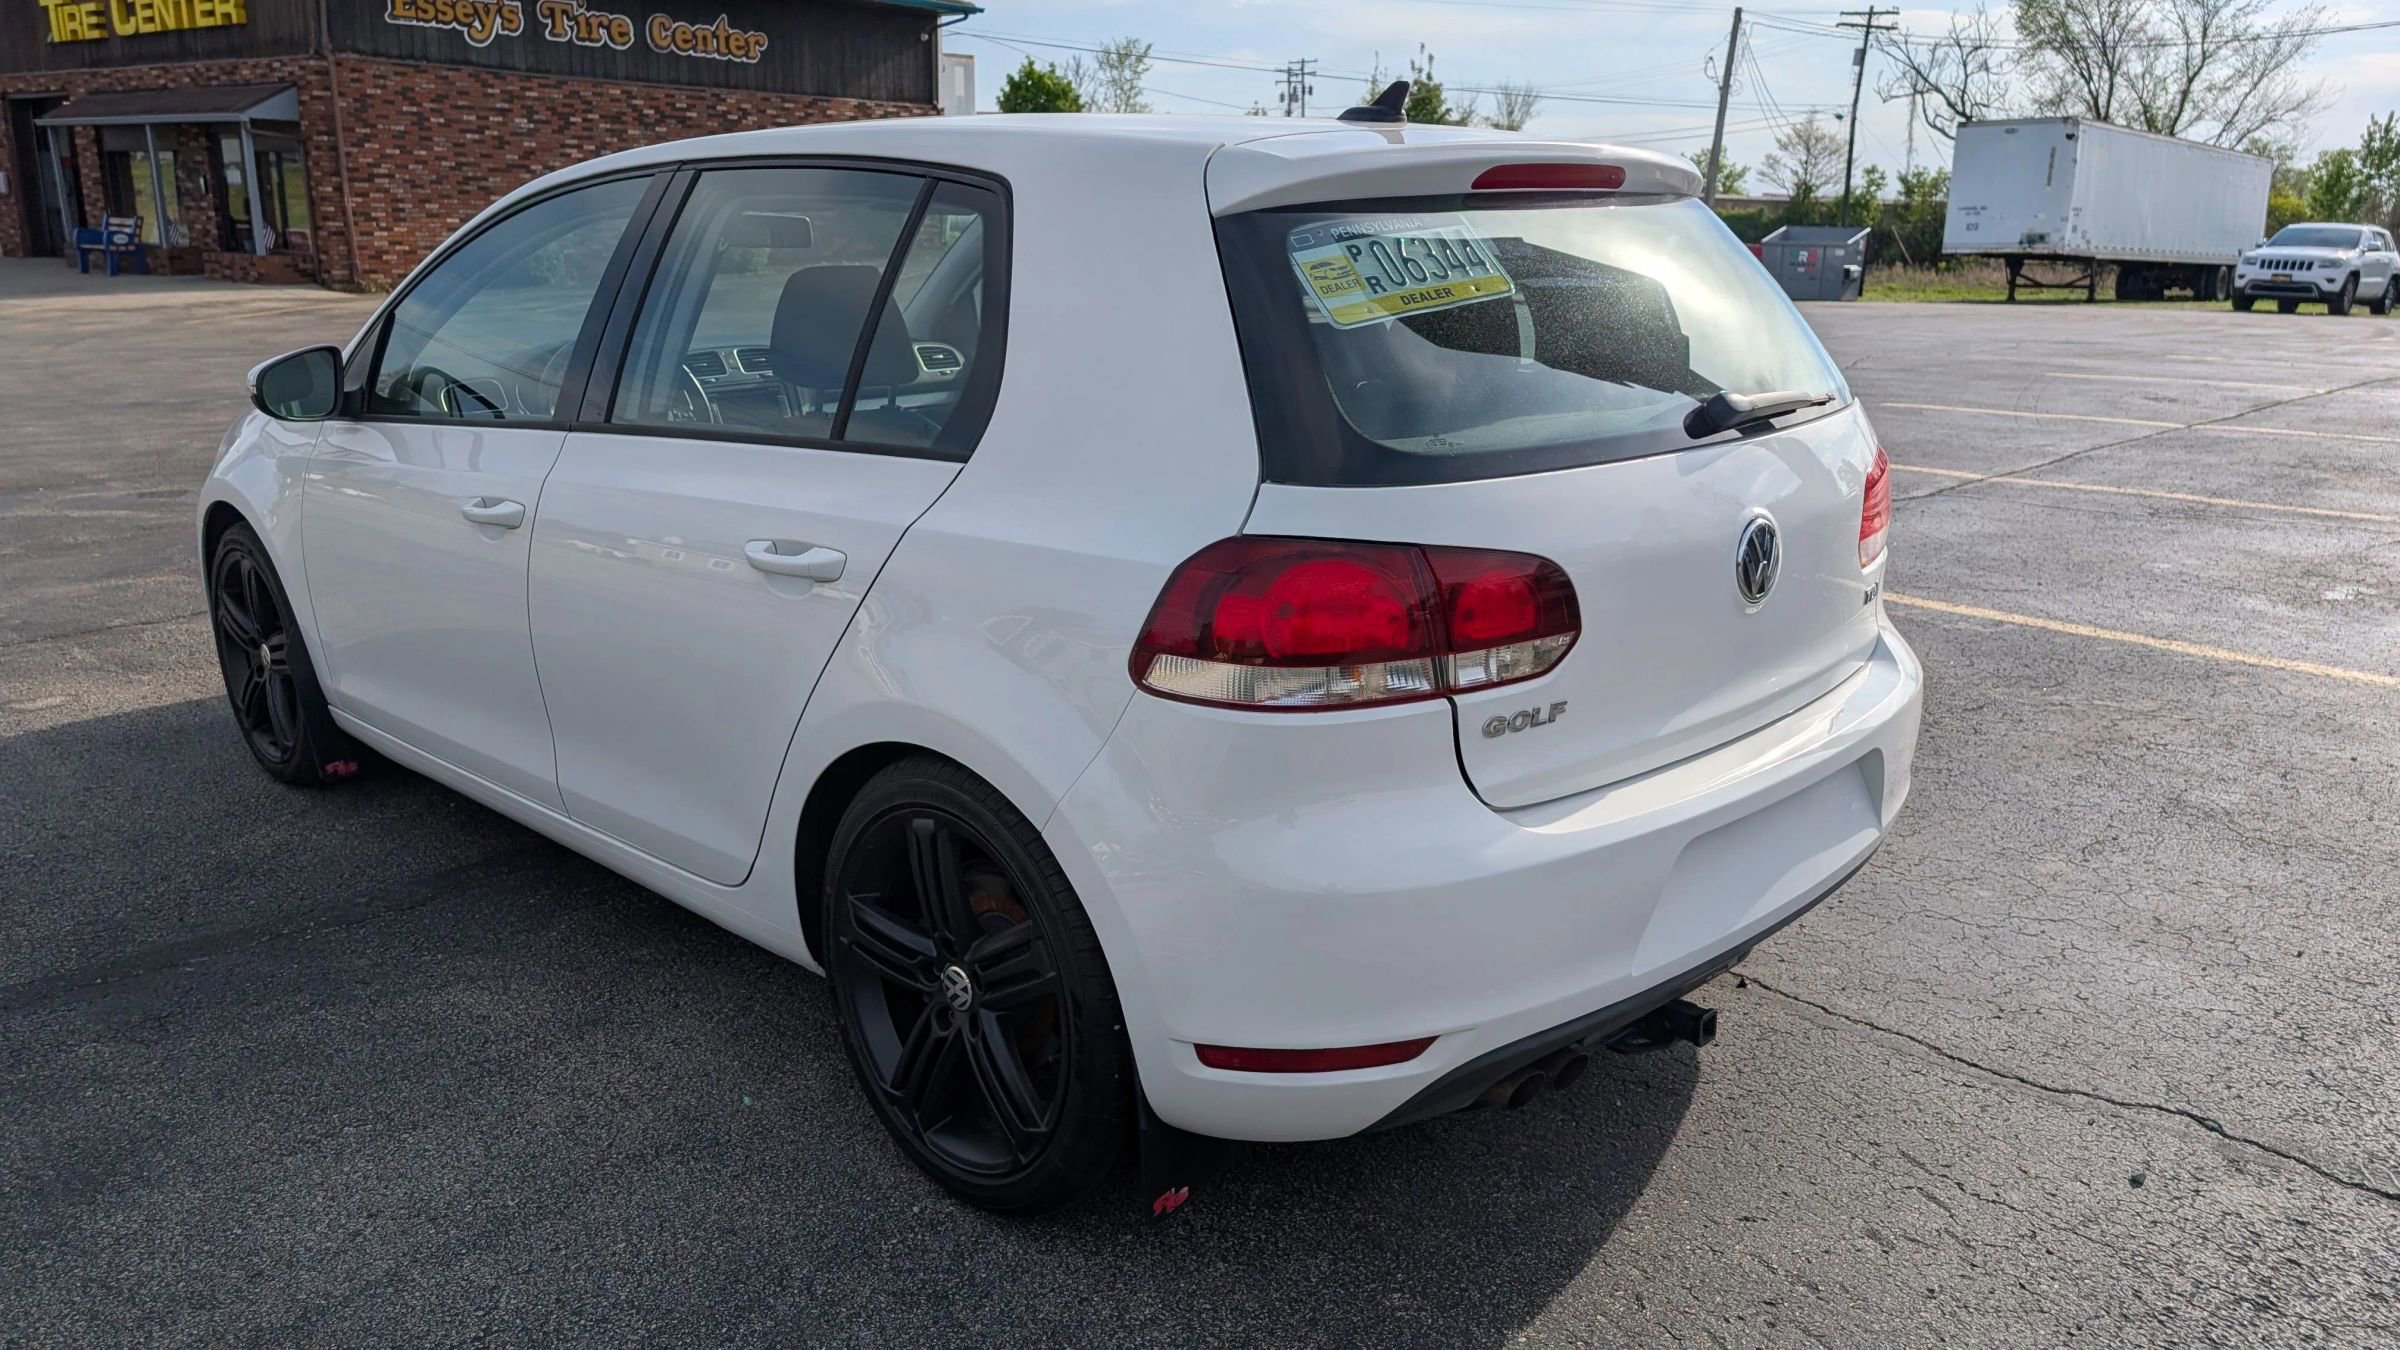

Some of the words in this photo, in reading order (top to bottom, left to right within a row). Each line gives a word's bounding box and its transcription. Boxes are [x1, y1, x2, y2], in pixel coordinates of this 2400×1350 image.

[40, 0, 109, 43] TIRE
[111, 0, 247, 36] CENTER
[538, 0, 634, 49] Tire
[647, 14, 767, 62] Center
[1331, 217, 1422, 240] PENNSYLVANIA
[1369, 229, 1494, 287] 06344
[1320, 279, 1361, 294] DEALER
[1400, 287, 1455, 305] DEALER
[1482, 700, 1568, 739] GOLF
